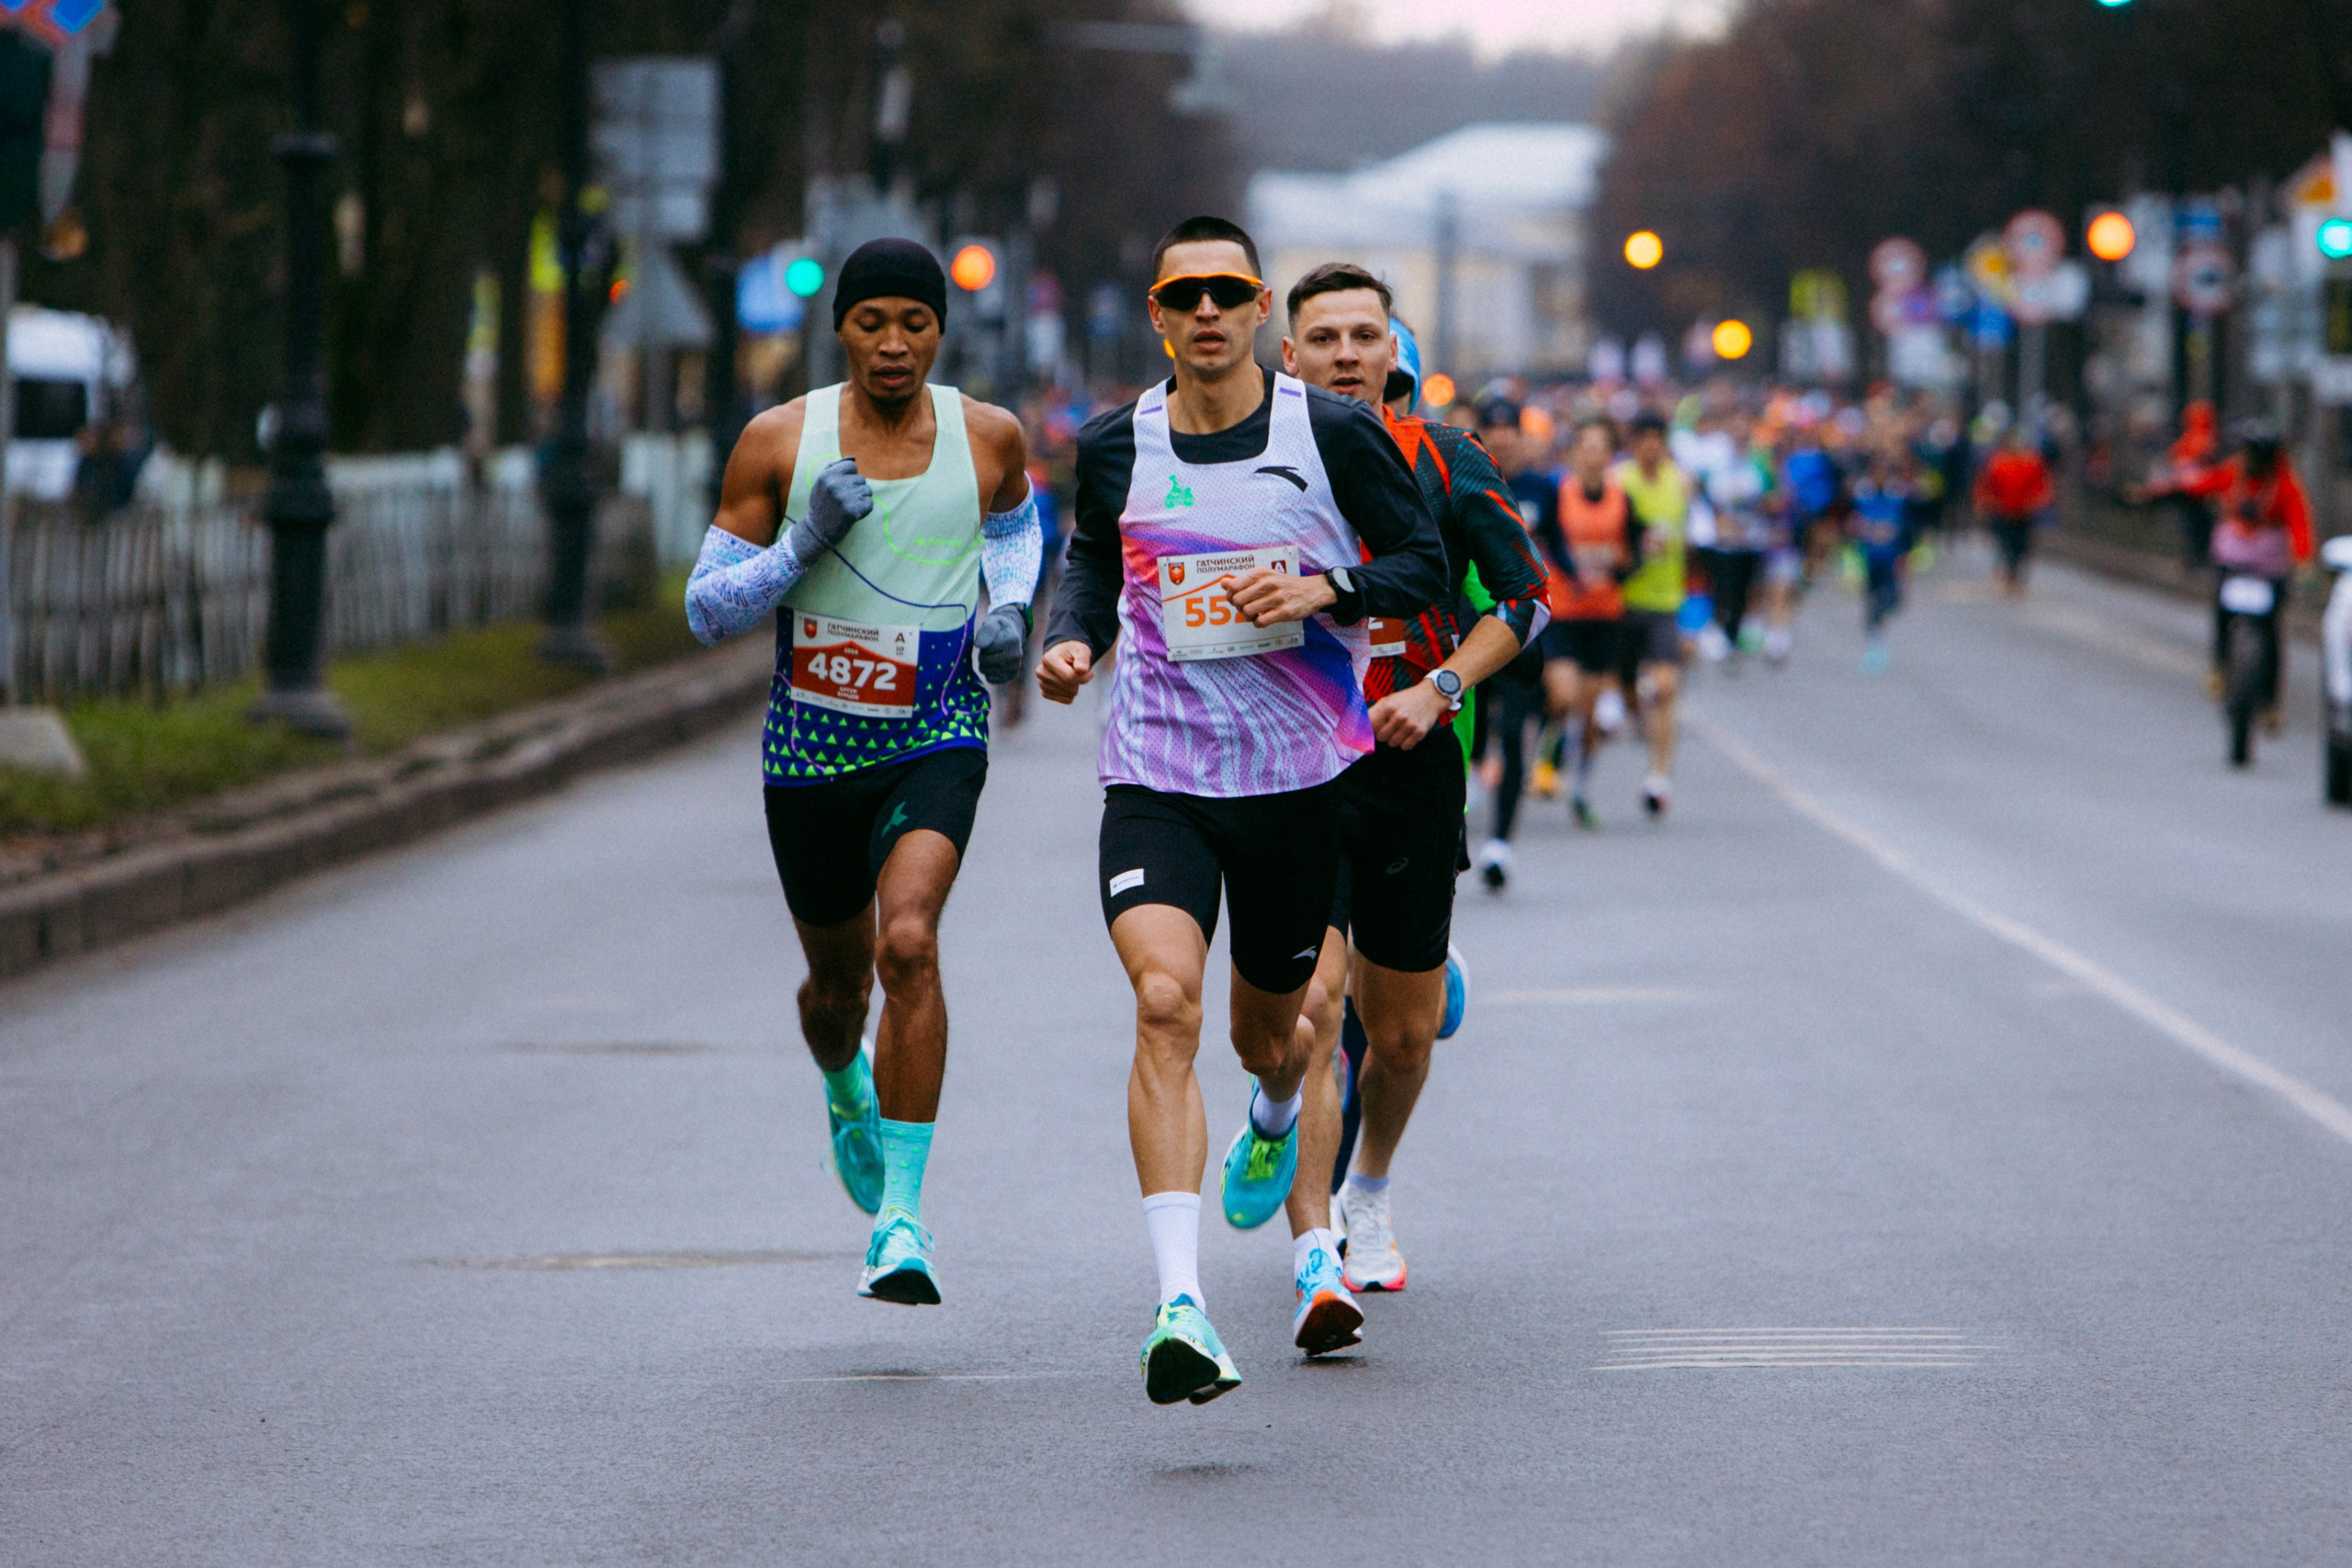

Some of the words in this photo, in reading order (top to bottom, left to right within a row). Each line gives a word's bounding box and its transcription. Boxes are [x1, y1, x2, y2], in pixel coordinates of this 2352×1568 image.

[1195, 555, 1255, 568] ГАТЧИНСКИЙ
[1196, 563, 1256, 574] ПОЛУМАРАФОН
[1185, 595, 1253, 627] 55
[827, 622, 879, 636] ГАТЧИНСКИЙ
[827, 628, 879, 642] ПОЛУМАРАФОН
[808, 651, 897, 691] 4872
